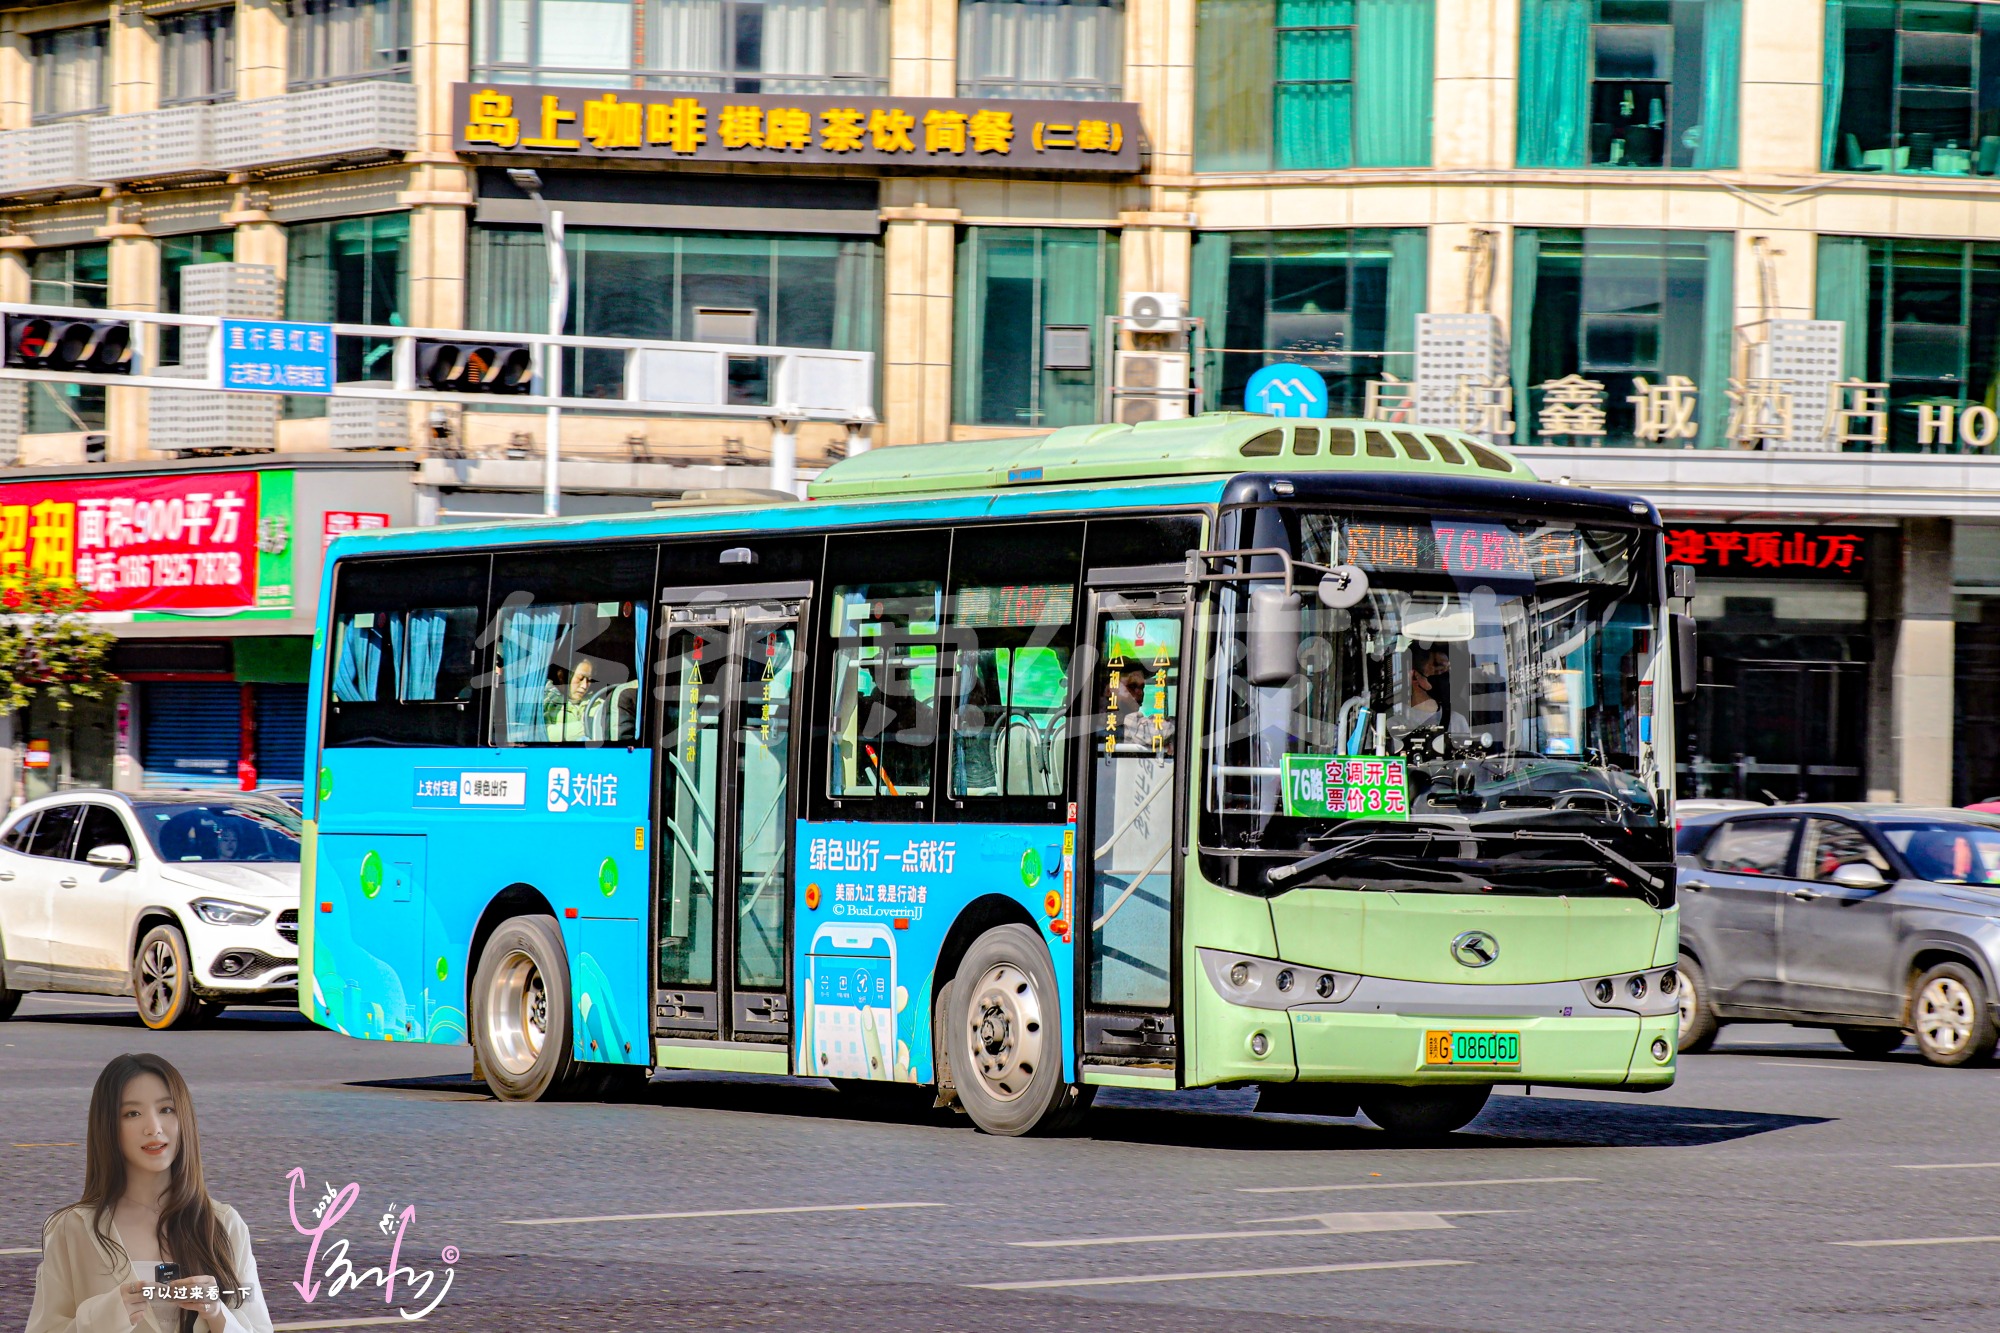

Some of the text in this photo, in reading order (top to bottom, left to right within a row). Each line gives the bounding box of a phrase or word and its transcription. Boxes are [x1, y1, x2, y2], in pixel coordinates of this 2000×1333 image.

[464, 89, 707, 155] 岛上咖啡
[717, 104, 1014, 156] 棋牌茶饮简餐
[77, 490, 245, 549] 面积900平方
[1434, 527, 1506, 572] 76路
[473, 780, 508, 798] 绿色出行
[570, 773, 618, 807] 支付宝
[1290, 767, 1324, 802] 76路
[1325, 760, 1404, 787] 空调开启
[1326, 786, 1405, 814] 票价3元
[809, 838, 957, 875] 绿色出行 一点就行
[835, 882, 927, 905] 美丽九江 我是行动者
